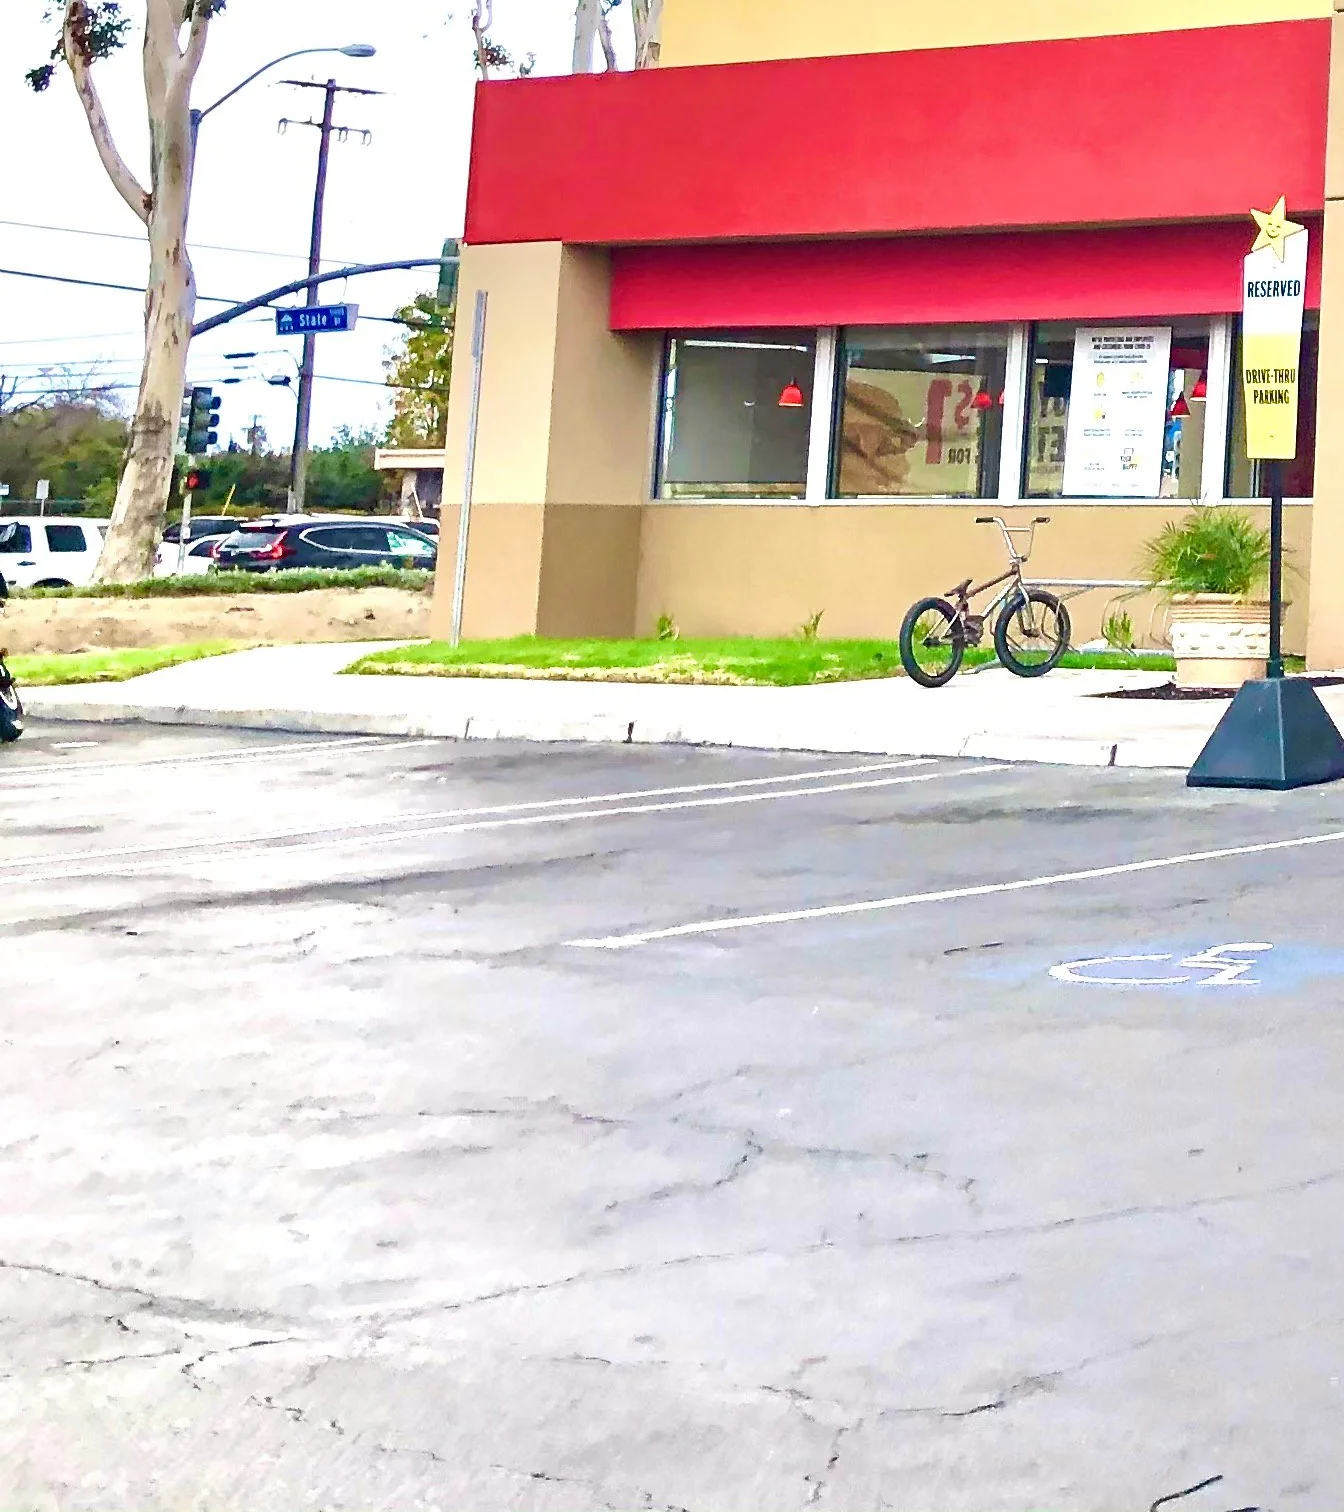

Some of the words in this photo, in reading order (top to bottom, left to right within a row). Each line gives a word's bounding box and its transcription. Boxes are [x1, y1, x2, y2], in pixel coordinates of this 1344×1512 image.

[1247, 280, 1301, 298] RESERVED
[299, 313, 327, 327] State
[1245, 368, 1296, 384] DRIVE-THRU
[1253, 389, 1290, 405] PARKING
